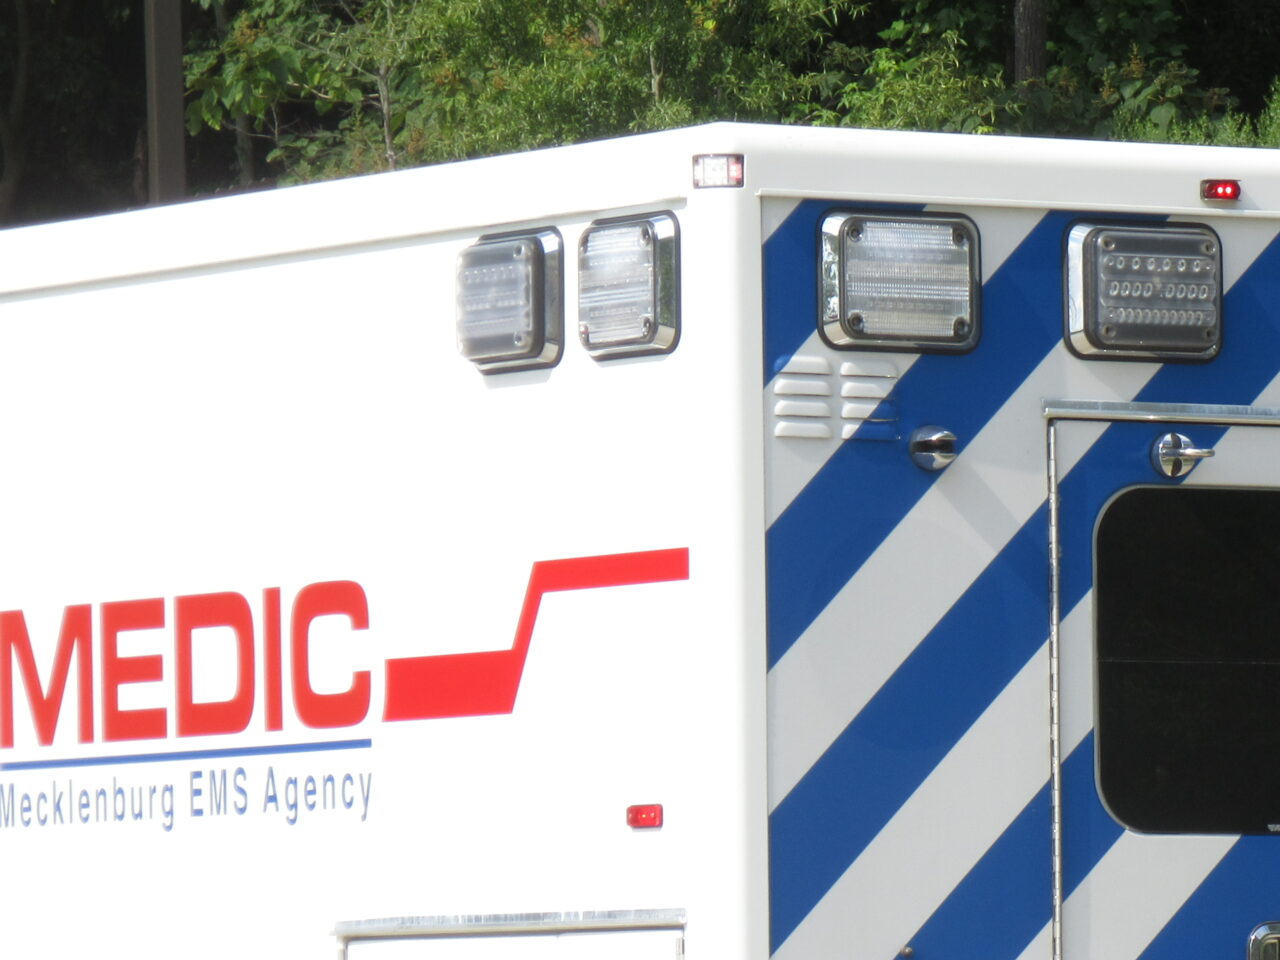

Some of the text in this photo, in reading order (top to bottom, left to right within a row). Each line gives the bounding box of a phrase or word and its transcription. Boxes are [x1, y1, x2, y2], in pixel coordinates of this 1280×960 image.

[0, 580, 371, 748] MEDIC
[0, 765, 372, 831] Mecklenburg EMS Agency
